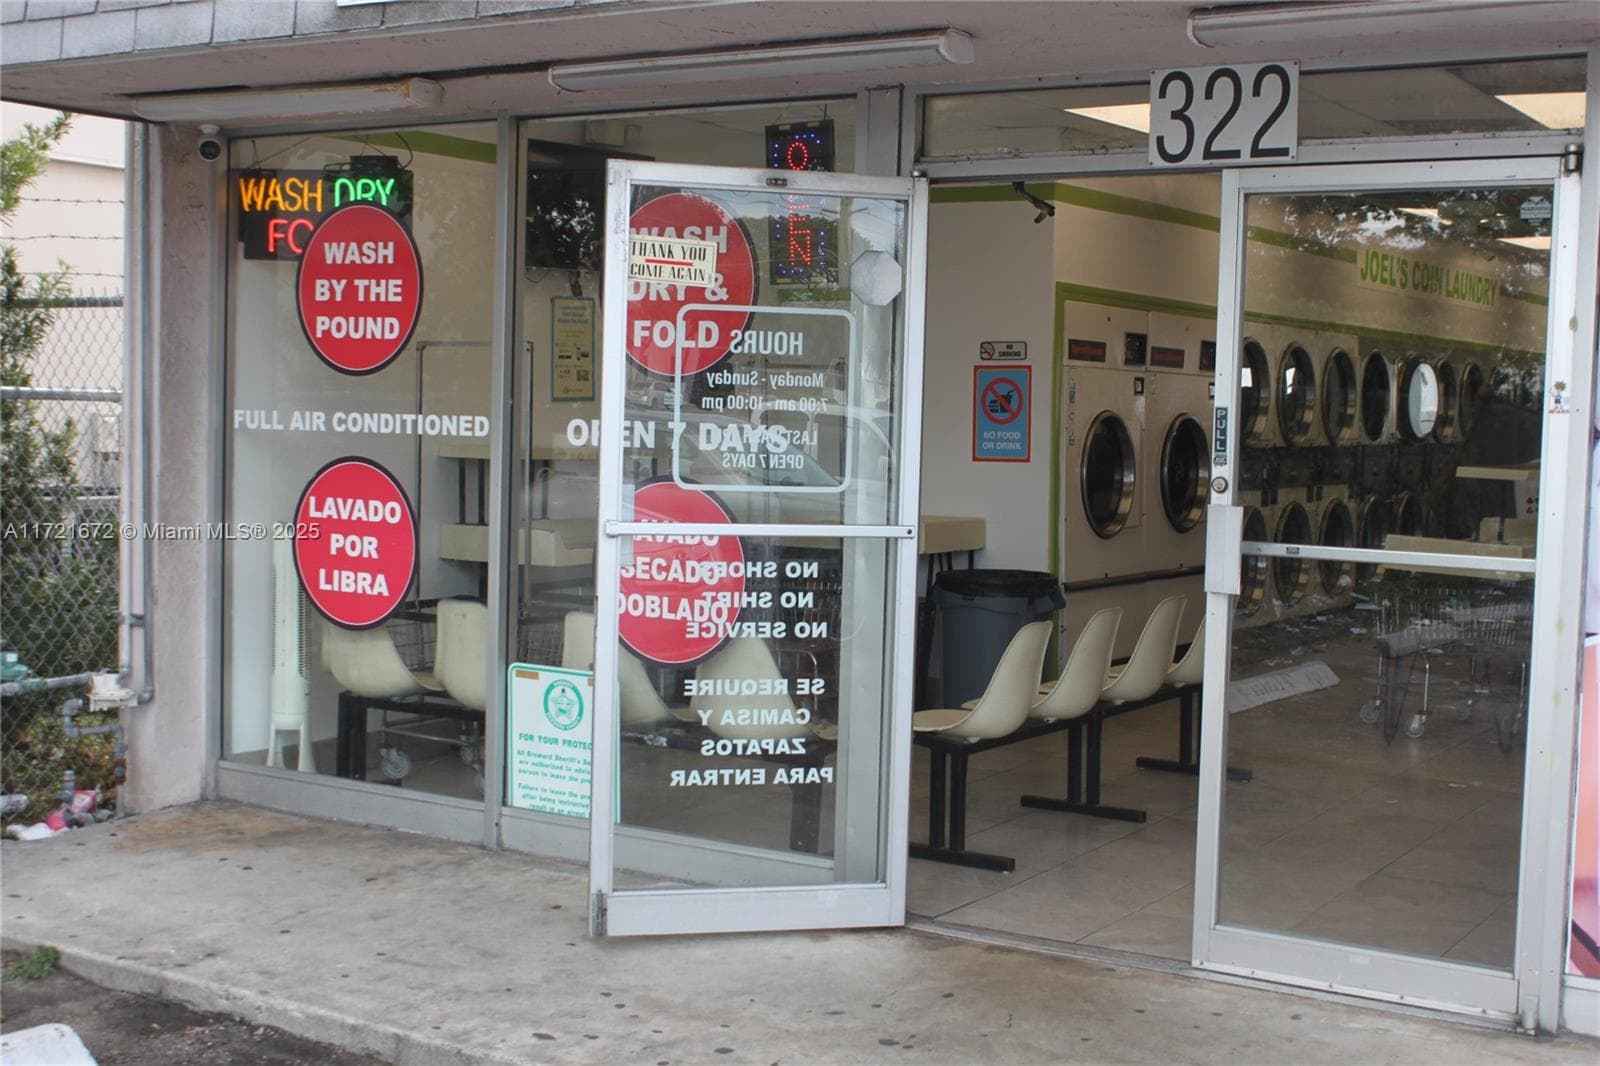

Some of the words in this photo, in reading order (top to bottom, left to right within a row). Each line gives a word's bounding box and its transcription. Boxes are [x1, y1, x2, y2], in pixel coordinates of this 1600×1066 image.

[1156, 64, 1291, 164] 322
[239, 177, 323, 212] WASH
[334, 178, 395, 207] DRY
[787, 141, 811, 266] OEN
[324, 242, 394, 264] WASH
[631, 241, 675, 259] THANK
[681, 245, 707, 262] YOU
[630, 263, 665, 278] COME
[670, 266, 706, 281] AGAIN
[1361, 249, 1408, 290] JOEL'S
[1412, 261, 1443, 295] COIN
[1446, 267, 1499, 306] LAUNDRY
[315, 279, 347, 301] BY
[354, 280, 402, 302] THE
[628, 280, 687, 301] DRY
[705, 273, 729, 301] &
[316, 316, 400, 340] POUND
[634, 320, 719, 348] FOLD
[233, 409, 284, 431] FULL
[290, 411, 326, 432] AIR
[332, 412, 490, 436] CONDITIONED
[984, 431, 996, 439] NO
[997, 431, 1021, 440] FOOD
[1216, 409, 1226, 450] PULL
[698, 423, 788, 453] DAYS
[982, 442, 994, 450] OR
[996, 442, 1022, 450] DRINK
[309, 496, 402, 524] LAVADO
[330, 533, 379, 559] POR
[319, 568, 390, 596] LIBRA
[620, 556, 720, 585] SECADO
[519, 732, 534, 743] FOR
[538, 735, 559, 745] YOUR
